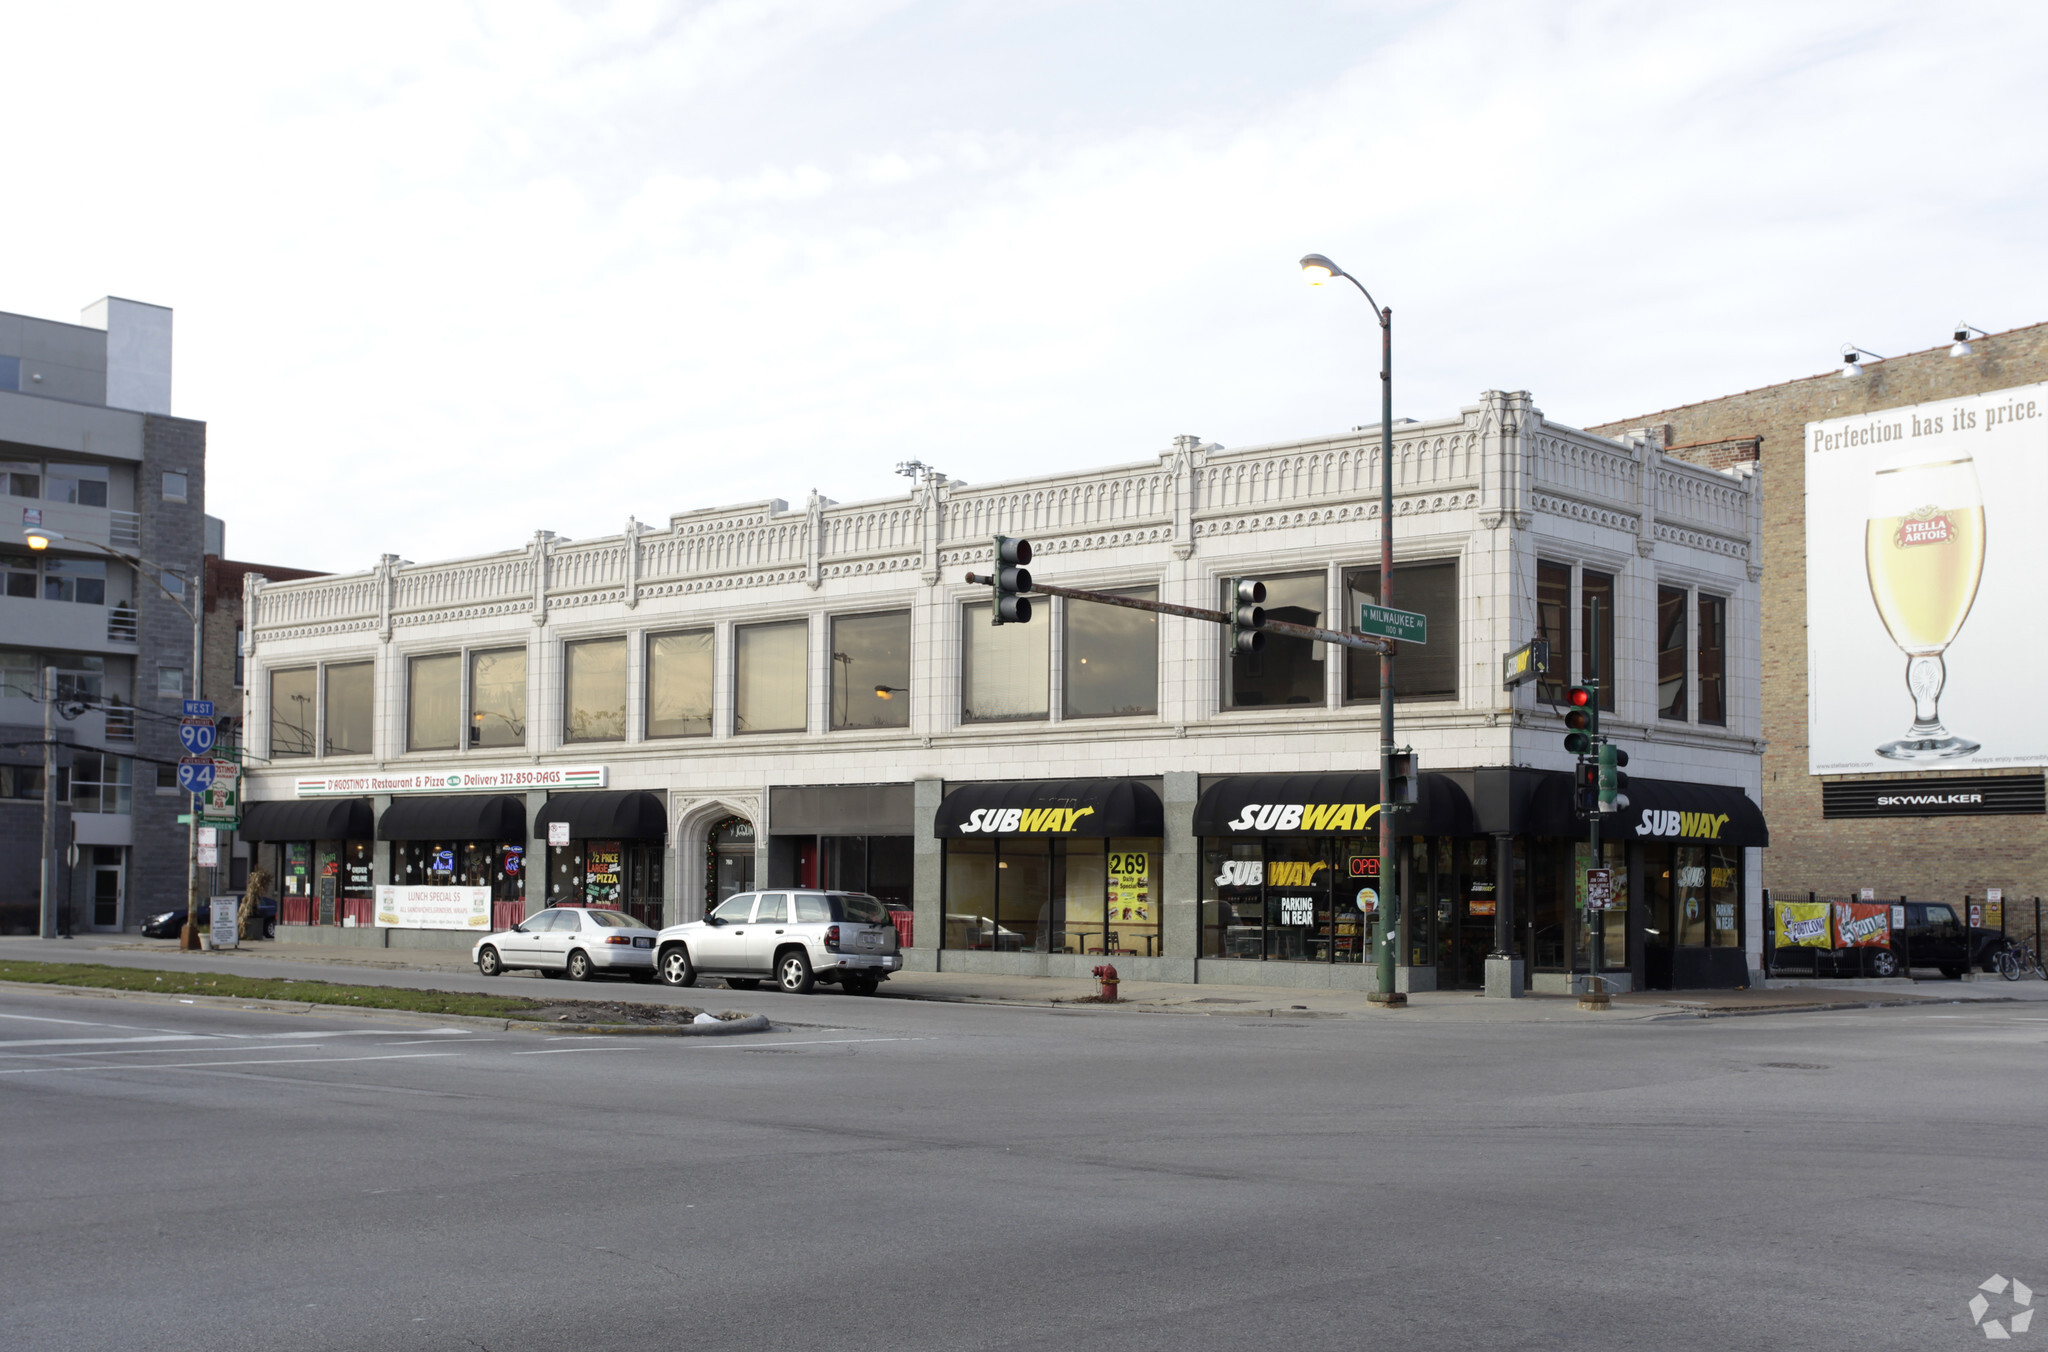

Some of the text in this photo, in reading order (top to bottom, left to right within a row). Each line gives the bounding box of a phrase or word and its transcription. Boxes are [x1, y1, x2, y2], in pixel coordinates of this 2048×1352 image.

[1813, 398, 2043, 453] Perfection has its price.
[1905, 520, 1946, 533] STELLA
[1905, 529, 1947, 543] ARTOIS
[1363, 608, 1424, 628] N MILWAUKEE AV
[1385, 625, 1396, 634] 1100
[1506, 648, 1530, 679] SUBWAY
[186, 703, 210, 714] WEST
[181, 726, 211, 748] 90
[180, 765, 212, 786] 94
[327, 778, 370, 790] D'AGOSTINO'S
[371, 777, 413, 790] Restaurant
[415, 776, 422, 787] &
[424, 776, 445, 787] Pizza
[464, 774, 498, 786] Delivery
[500, 771, 561, 785] 312-850-DAGS
[1877, 794, 1982, 805] SKYWALKER
[959, 806, 1095, 834] SUBWAY
[1228, 803, 1381, 832] SUBWAY
[1635, 808, 1730, 839] SUBWAY
[601, 853, 619, 863] PRICE
[351, 866, 368, 874] ORDER
[587, 858, 608, 873] LARGE
[596, 874, 618, 883] PIZZA
[408, 891, 428, 902] LUNCH
[429, 891, 452, 902] SPECIAL
[1281, 897, 1313, 911] PARKING
[1715, 904, 1734, 917] PARKING
[1281, 911, 1313, 925] IN REAR
[1715, 917, 1734, 930] IN REAR
